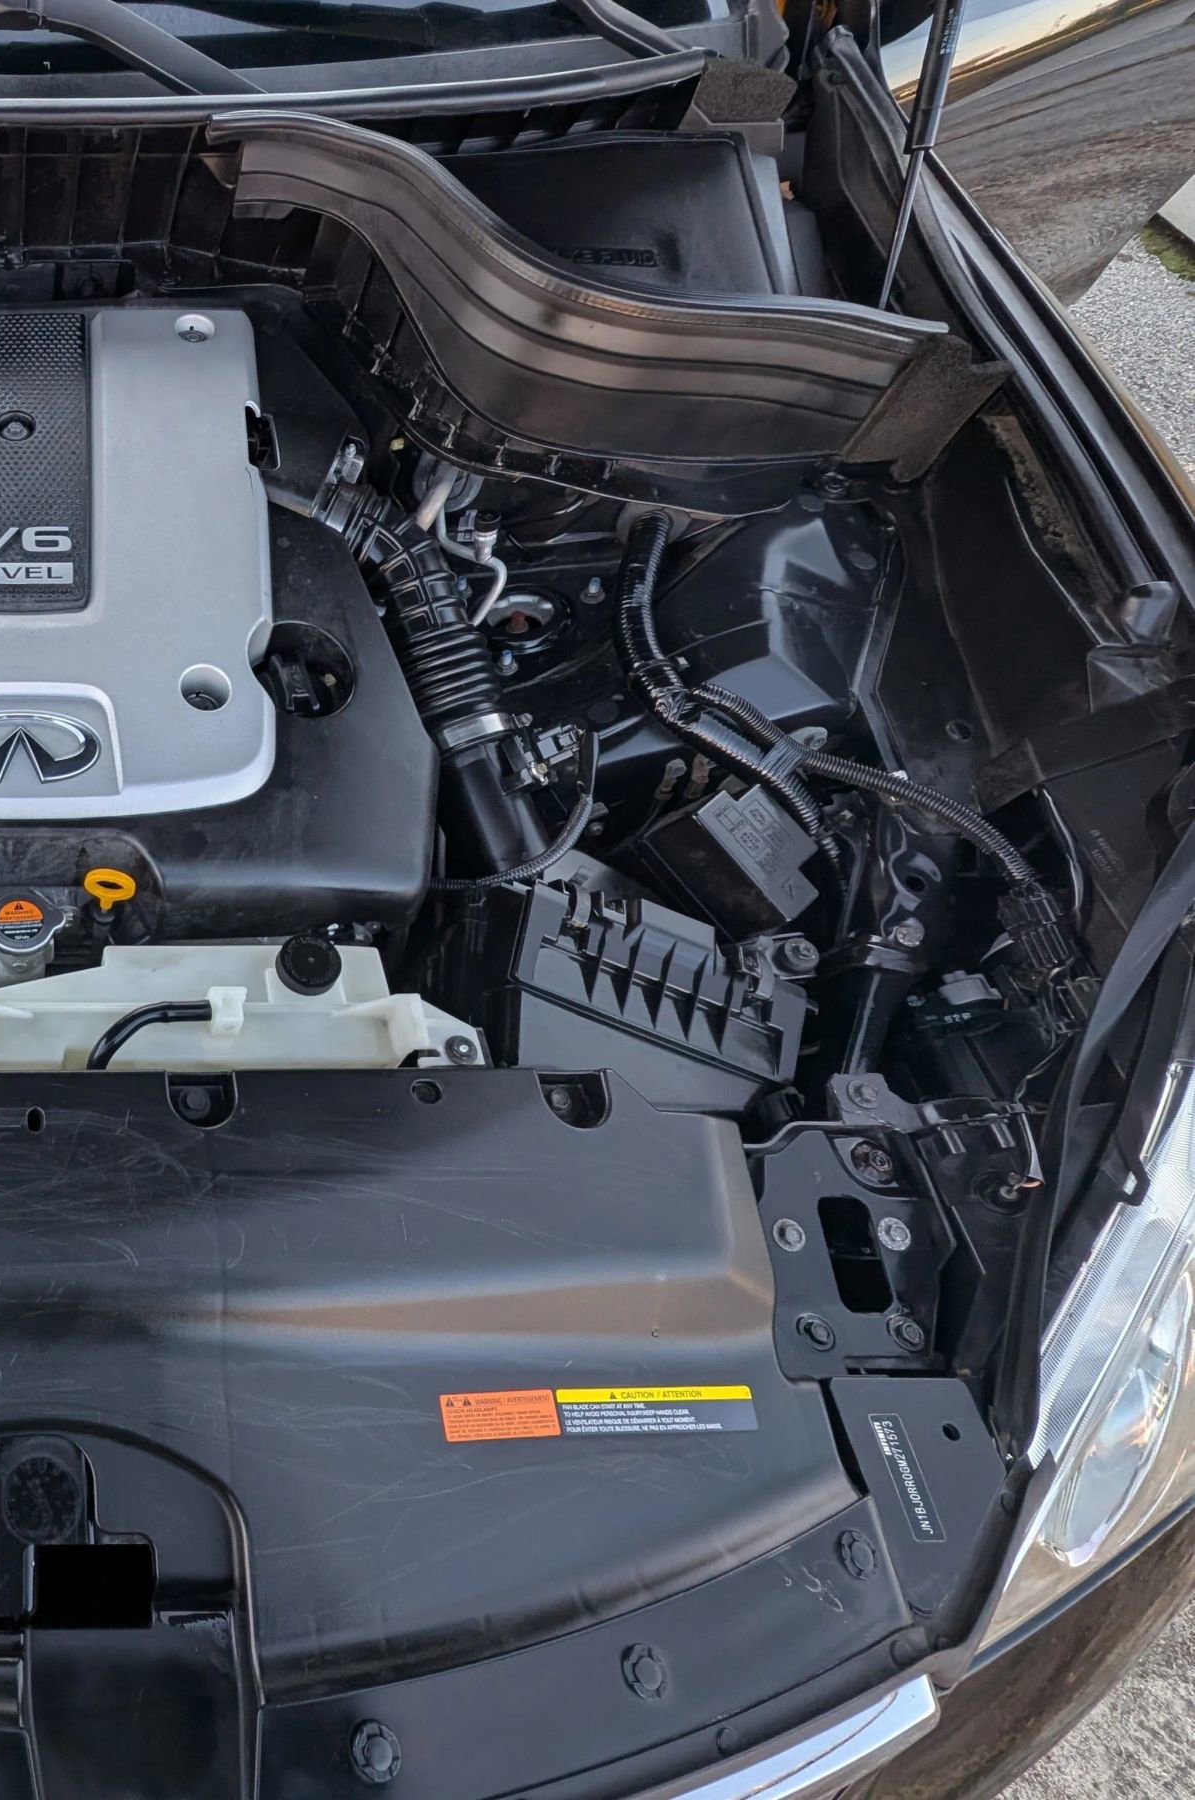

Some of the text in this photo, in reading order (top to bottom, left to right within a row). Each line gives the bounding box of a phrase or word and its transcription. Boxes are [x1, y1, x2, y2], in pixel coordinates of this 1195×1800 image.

[621, 1391, 654, 1400] CAUTION
[662, 1390, 702, 1399] ATTENTION
[474, 1397, 503, 1405] WARNING
[873, 1421, 892, 1456] INFINITI
